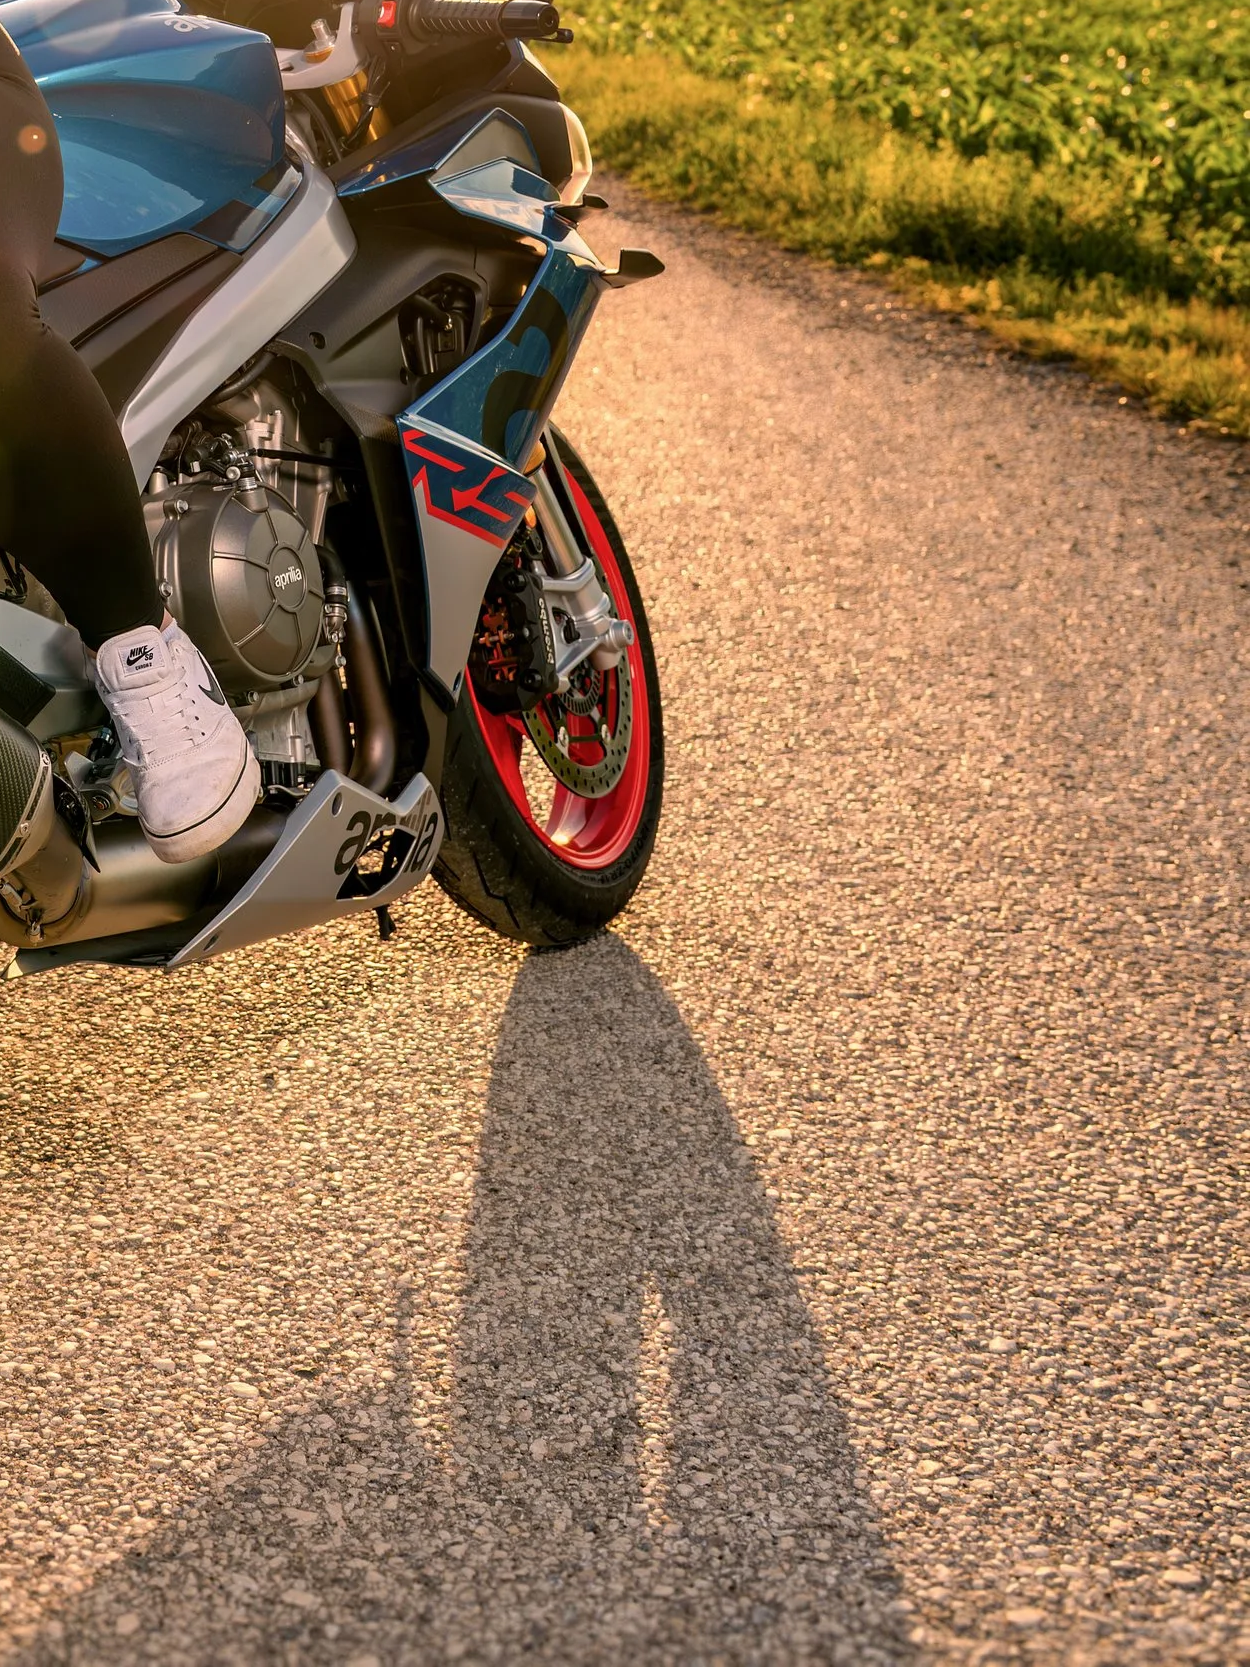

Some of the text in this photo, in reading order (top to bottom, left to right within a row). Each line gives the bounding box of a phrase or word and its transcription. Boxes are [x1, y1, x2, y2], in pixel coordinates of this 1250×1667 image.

[274, 565, 303, 591] aprilia
[538, 597, 555, 664] brembo
[129, 644, 149, 659] NIKE
[144, 652, 154, 662] SB
